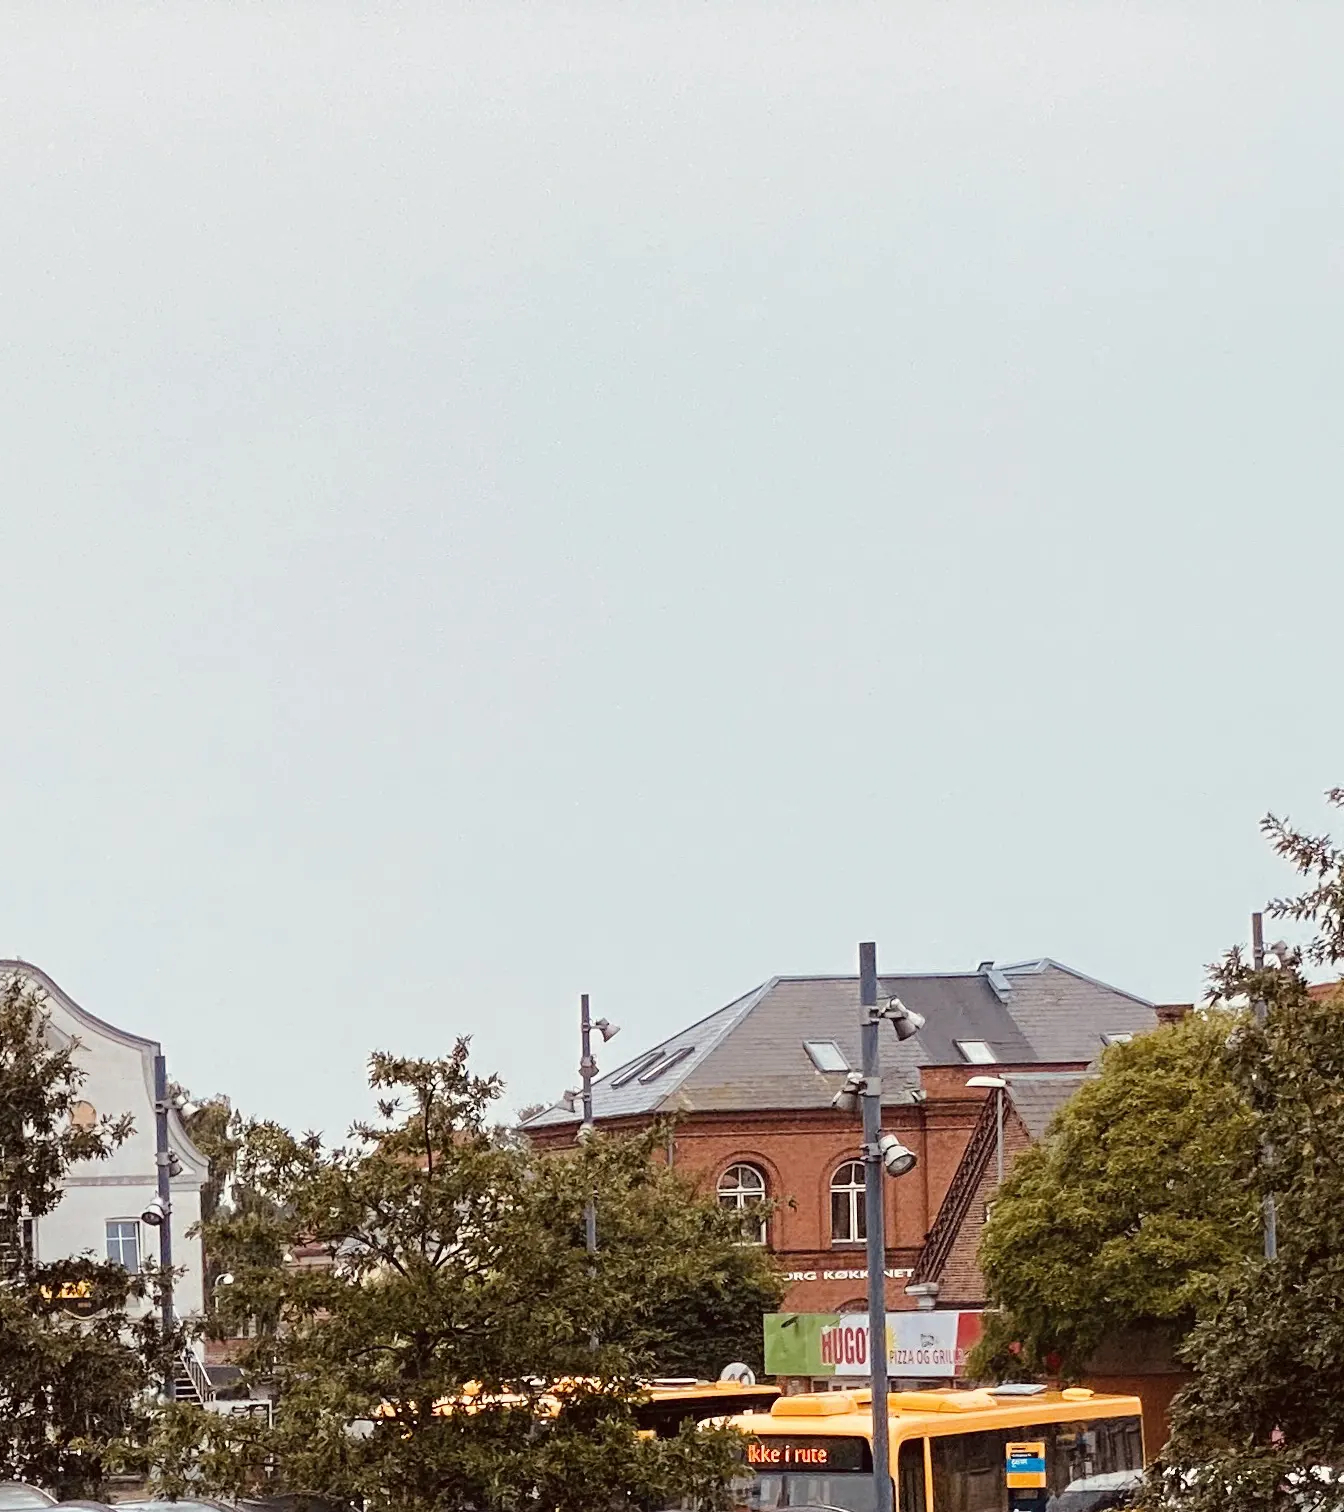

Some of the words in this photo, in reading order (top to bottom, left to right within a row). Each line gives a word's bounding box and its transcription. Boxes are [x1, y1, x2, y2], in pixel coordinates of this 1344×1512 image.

[823, 1269, 914, 1280] KØKKNET
[821, 1327, 870, 1364] HUGO'
[889, 1349, 914, 1365] PIZZA
[916, 1349, 930, 1365] OG
[748, 1445, 780, 1463] Ikke
[785, 1445, 790, 1463] i
[795, 1447, 827, 1463] rute
